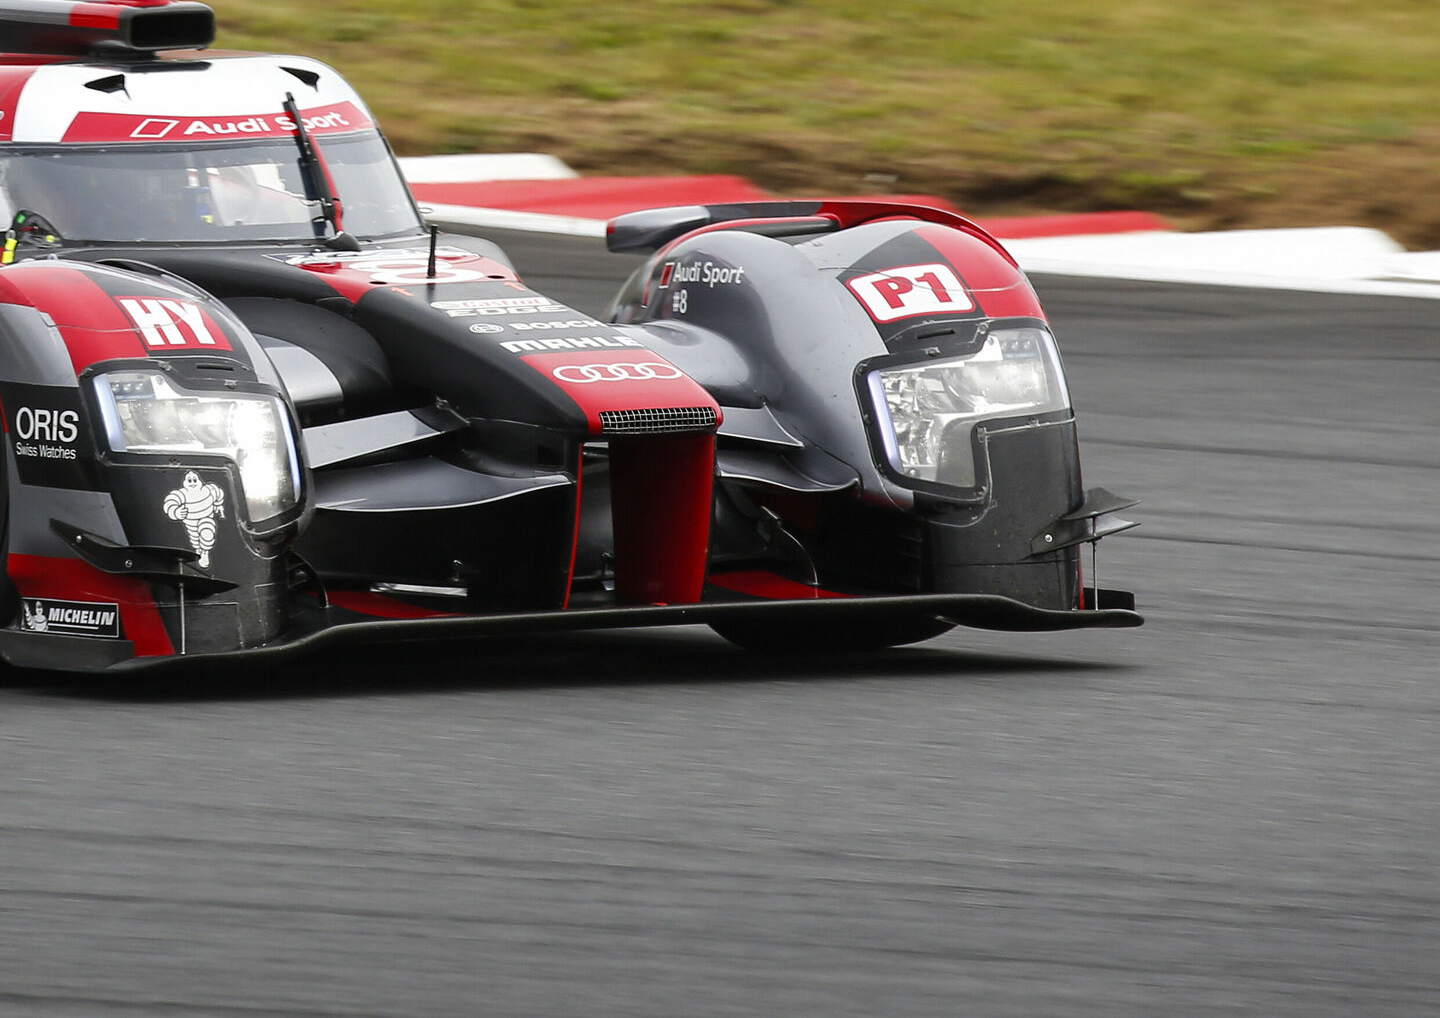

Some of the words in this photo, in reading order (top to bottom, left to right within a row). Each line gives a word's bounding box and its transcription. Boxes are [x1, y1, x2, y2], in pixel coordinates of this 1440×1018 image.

[184, 118, 271, 136] Audi
[274, 111, 350, 133] Sport
[672, 262, 702, 282] Audi
[702, 261, 744, 288] Sport
[672, 289, 688, 314] #8
[871, 272, 953, 309] P1
[119, 299, 216, 346] HY
[446, 304, 570, 318] EDGE
[509, 319, 608, 331] BOSCH
[499, 335, 645, 353] MAHLE
[16, 406, 79, 442] ORIS
[16, 442, 37, 457] Swiss
[39, 444, 77, 460] Watches
[48, 608, 115, 626] MICHELIN
